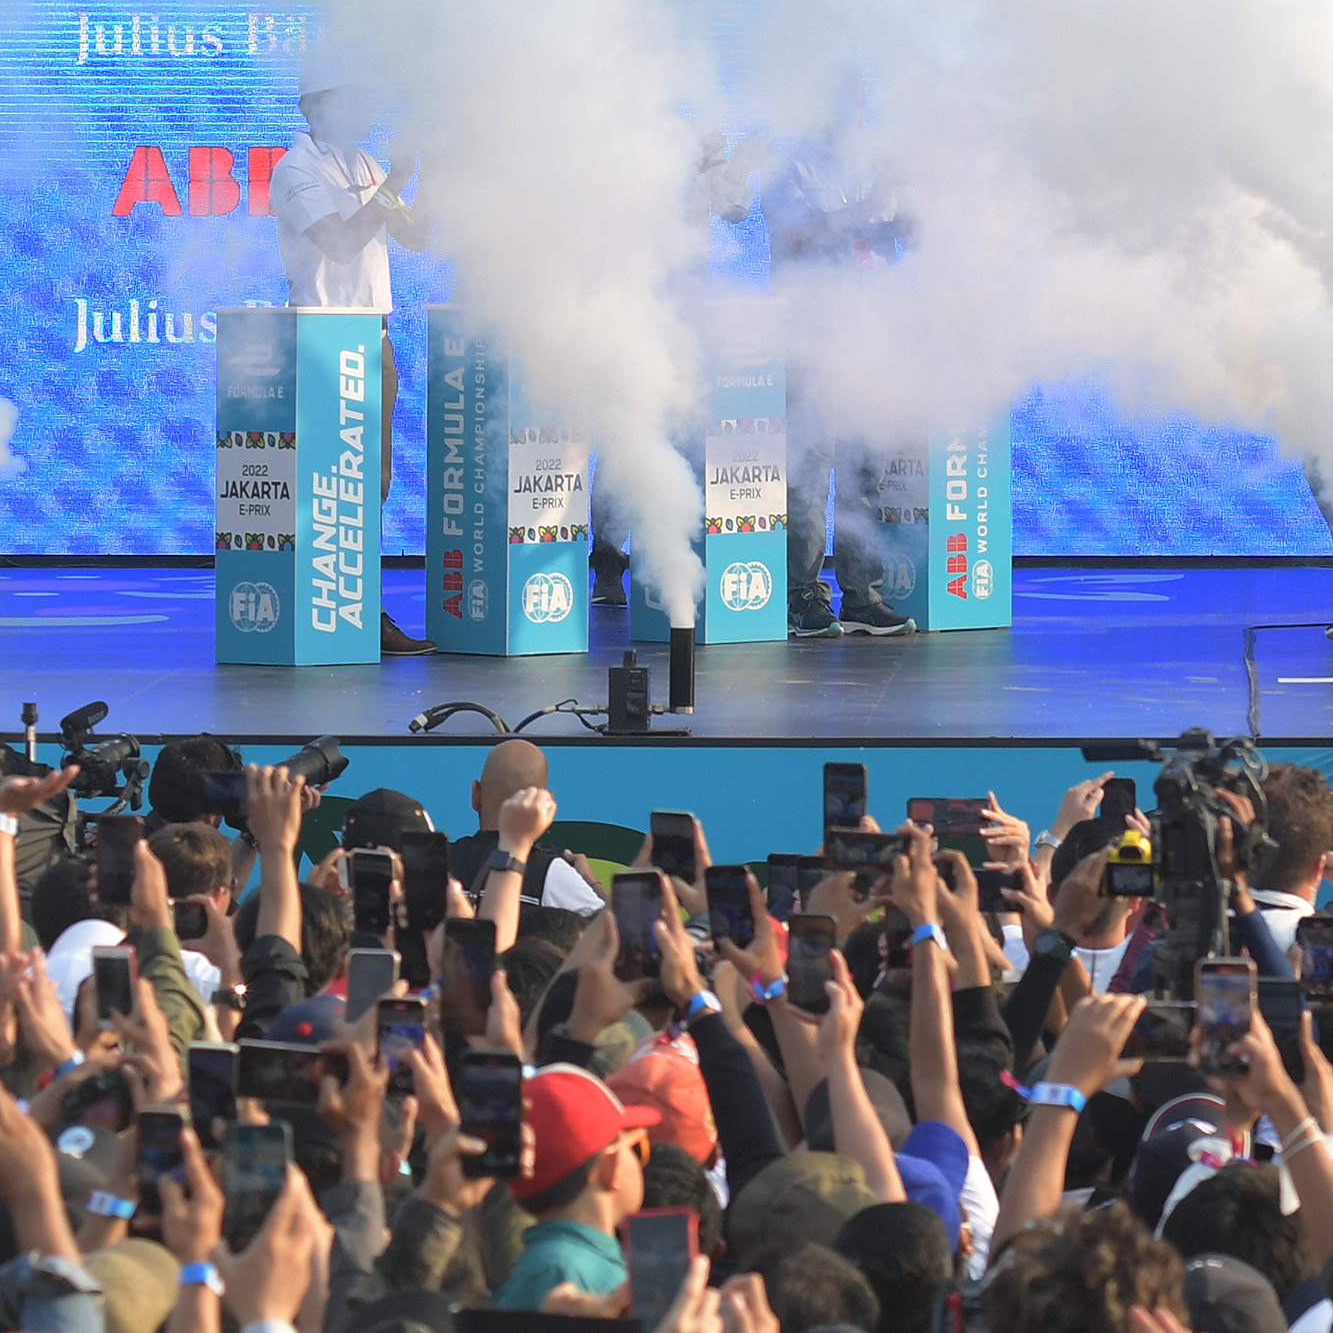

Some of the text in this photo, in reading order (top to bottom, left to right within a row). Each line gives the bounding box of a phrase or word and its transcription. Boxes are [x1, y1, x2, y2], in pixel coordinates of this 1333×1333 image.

[76, 13, 223, 65] Julius
[74, 298, 218, 352] Julius
[716, 374, 774, 388] FORMULA E
[227, 384, 284, 400] FORMULA E
[474, 338, 486, 493] CHAMPIONSHIP
[535, 459, 562, 471] 2022
[732, 451, 759, 464] 2022
[242, 464, 269, 477] 2022
[443, 336, 466, 620] ABB FORMULA E
[710, 465, 781, 486] JAKARTA
[220, 481, 291, 501] JAKARTA
[338, 344, 365, 630] ACCELERATED.
[513, 473, 583, 494] JAKARTA
[729, 487, 762, 501] E-PRIX
[239, 503, 271, 516] E-PRIX
[532, 496, 564, 510] E-PRIX
[977, 485, 989, 554] WORLD
[474, 502, 485, 573] WORLD
[312, 464, 338, 634] CHANGE.
[946, 532, 968, 600] ABB
